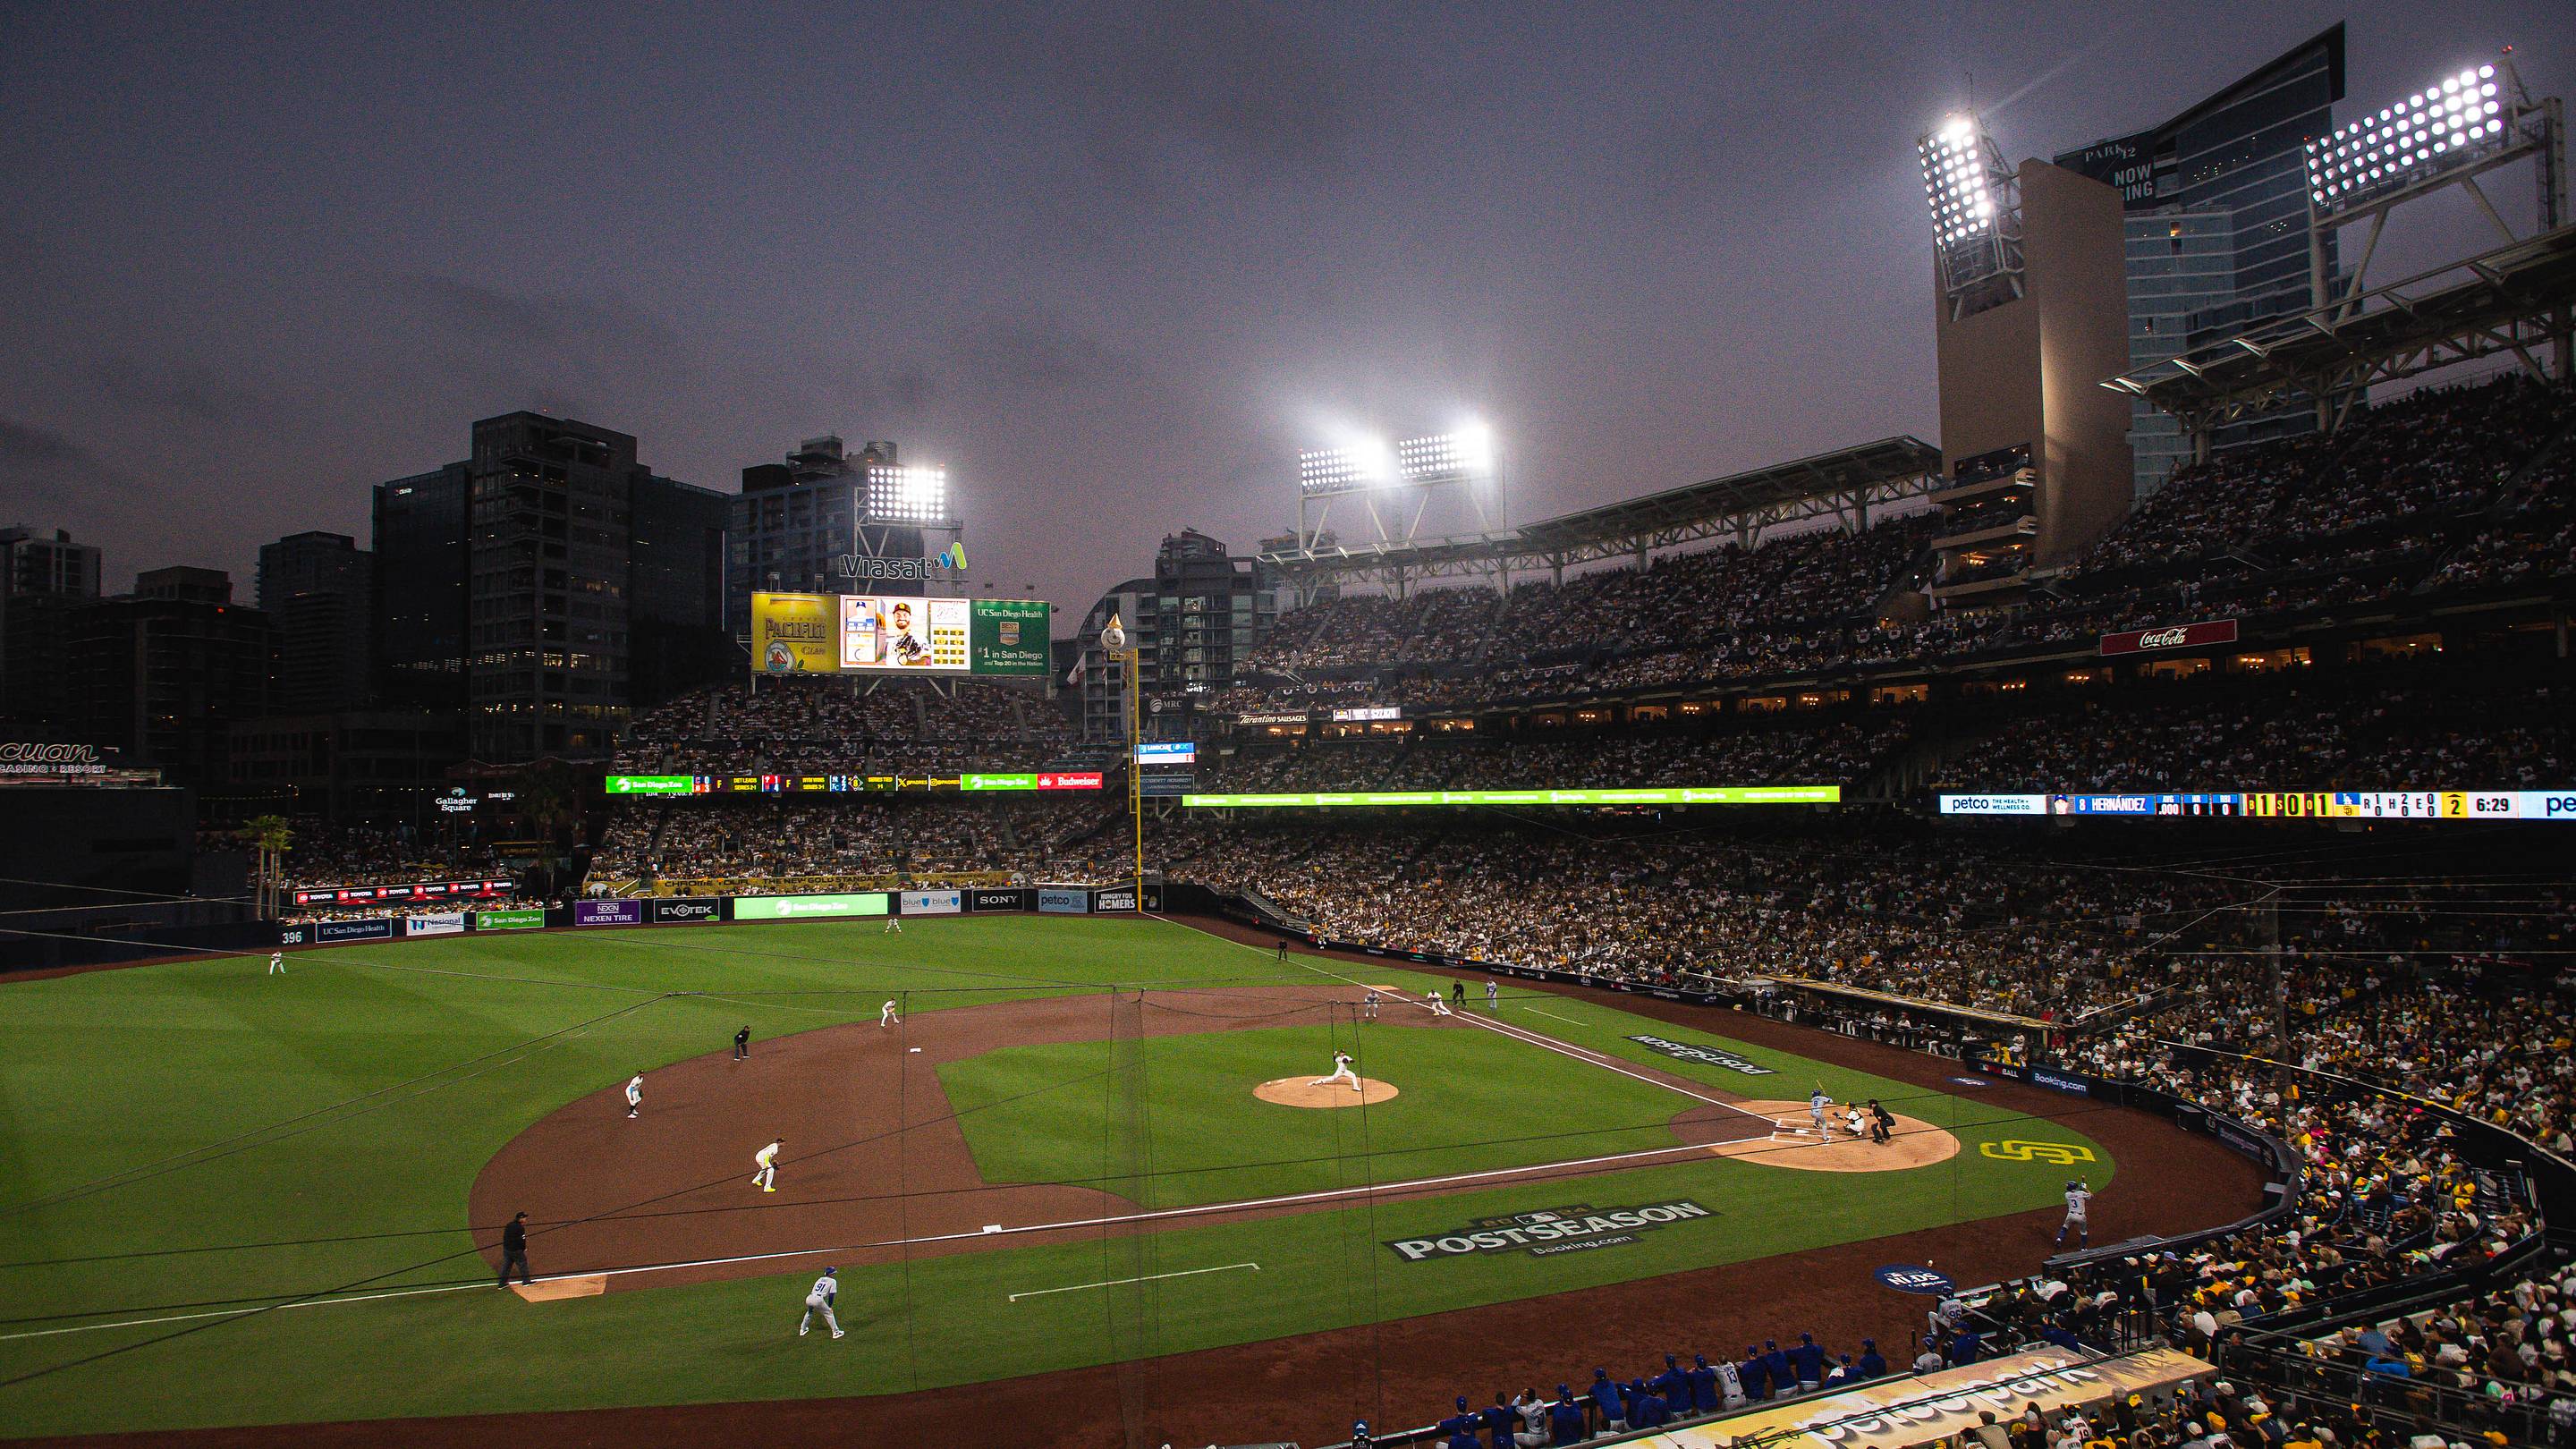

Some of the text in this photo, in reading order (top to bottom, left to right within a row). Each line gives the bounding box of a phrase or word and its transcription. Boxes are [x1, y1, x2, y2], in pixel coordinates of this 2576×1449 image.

[2114, 163, 2152, 186] NOW
[2120, 181, 2153, 201] ING
[843, 554, 931, 580] Viasat
[989, 609, 1002, 617] San
[1003, 610, 1021, 618] Diego
[992, 650, 999, 658] in
[1001, 650, 1018, 658] San
[1019, 651, 1043, 661] Diego
[1163, 700, 1182, 708] MRC
[1240, 715, 1307, 724] Tarantino SAUSAGES
[0, 764, 106, 774] CASINO RESORT
[704, 775, 709, 784] 0
[716, 779, 722, 788] F
[1058, 776, 1099, 786] Budweiser
[1953, 797, 1988, 812] petco
[2079, 795, 2146, 811] 8 HERNÁNDEZ
[2364, 799, 2370, 809] R
[2375, 794, 2381, 804] 1
[2389, 799, 2396, 809] H
[2401, 794, 2408, 805] 2
[2417, 799, 2422, 809] E
[2428, 794, 2434, 805] 0
[2158, 804, 2179, 815] .000
[2193, 804, 2199, 815] 0
[2223, 804, 2229, 815] 0
[2249, 795, 2268, 815] B 1
[2277, 795, 2299, 815] S 0
[2318, 795, 2326, 815] 1
[2452, 800, 2460, 815] 2
[2477, 798, 2510, 812] 6:29
[2375, 806, 2381, 816] 0
[2401, 806, 2409, 817] 0
[2428, 806, 2434, 817] 0
[665, 879, 713, 887] CHROME
[807, 877, 835, 885] GOLD
[837, 875, 886, 884] STANDARD
[902, 897, 921, 906] blue
[932, 896, 951, 905] blue
[980, 895, 1018, 904] SONY
[1041, 894, 1069, 906] petco
[1099, 899, 1136, 910] HOMERS
[508, 917, 527, 925] Diego
[584, 914, 632, 923] NEXEN TIRE
[347, 926, 364, 936] Diego
[365, 924, 385, 933] Health
[283, 931, 301, 945] 396
[2034, 1073, 2087, 1092] Booking.com
[2072, 1199, 2078, 1208] 3
[1394, 1202, 1710, 1258] POSTSEASON
[1532, 1234, 1633, 1255] Booking.com
[815, 1283, 826, 1292] 91
[1725, 1370, 1738, 1385] 13
